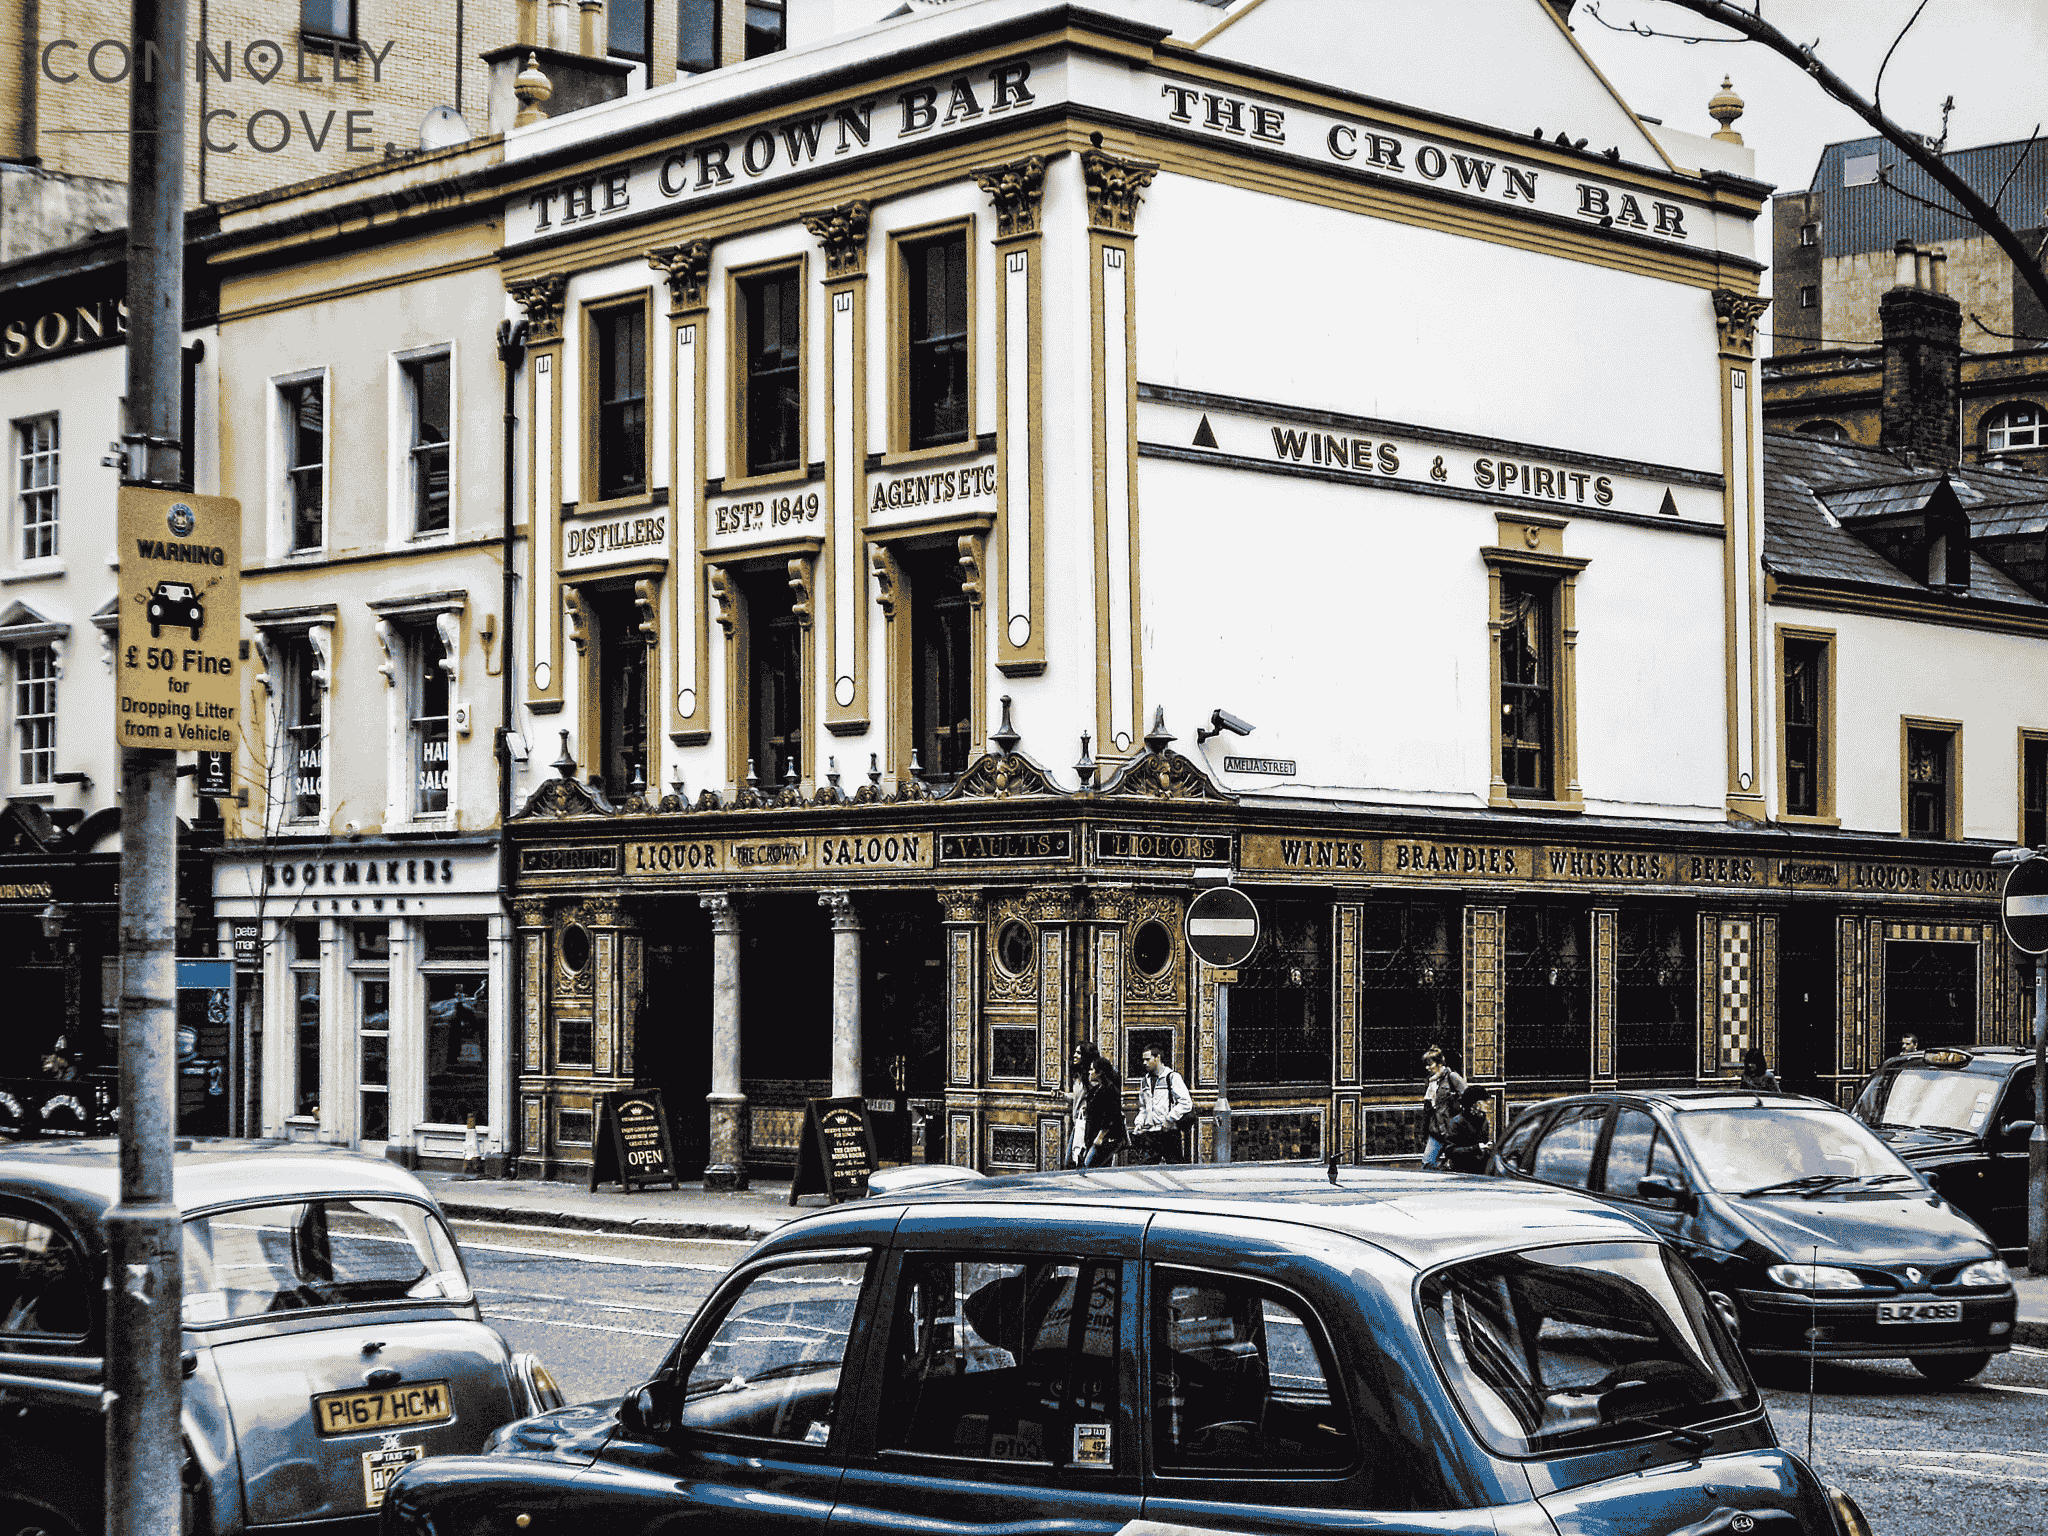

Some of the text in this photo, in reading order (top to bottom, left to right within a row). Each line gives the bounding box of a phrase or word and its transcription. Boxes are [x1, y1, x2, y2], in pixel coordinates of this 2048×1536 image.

[528, 60, 1036, 233] THE CROWN BAR
[1162, 84, 1688, 238] THE CROWN BAR
[1271, 426, 1615, 507] WINES & SPIRITS
[871, 470, 956, 513] AGENTS
[771, 493, 819, 528] 1849
[567, 516, 665, 558] DISTILLERS
[136, 539, 225, 567] WARNING
[146, 647, 174, 671] 50
[182, 648, 232, 675] Fine
[168, 676, 190, 693] for
[121, 696, 235, 720] Dropping Litter
[125, 719, 231, 742] from a Vehicle
[423, 742, 448, 762] HAI
[1226, 758, 1294, 774] AMELIA STREET
[419, 770, 449, 790] SALO
[635, 843, 717, 871] LIQUOR
[736, 846, 756, 864] THE
[757, 845, 802, 865] CROWN
[957, 834, 1051, 857] VAULTS
[1114, 836, 1217, 859] LIQUORS
[264, 859, 452, 888] BOOKMAKERS
[1856, 865, 1922, 891] LIQUOR
[234, 926, 260, 939] pete
[628, 1150, 663, 1165] OPEN
[328, 1388, 441, 1427] P167 HCM
